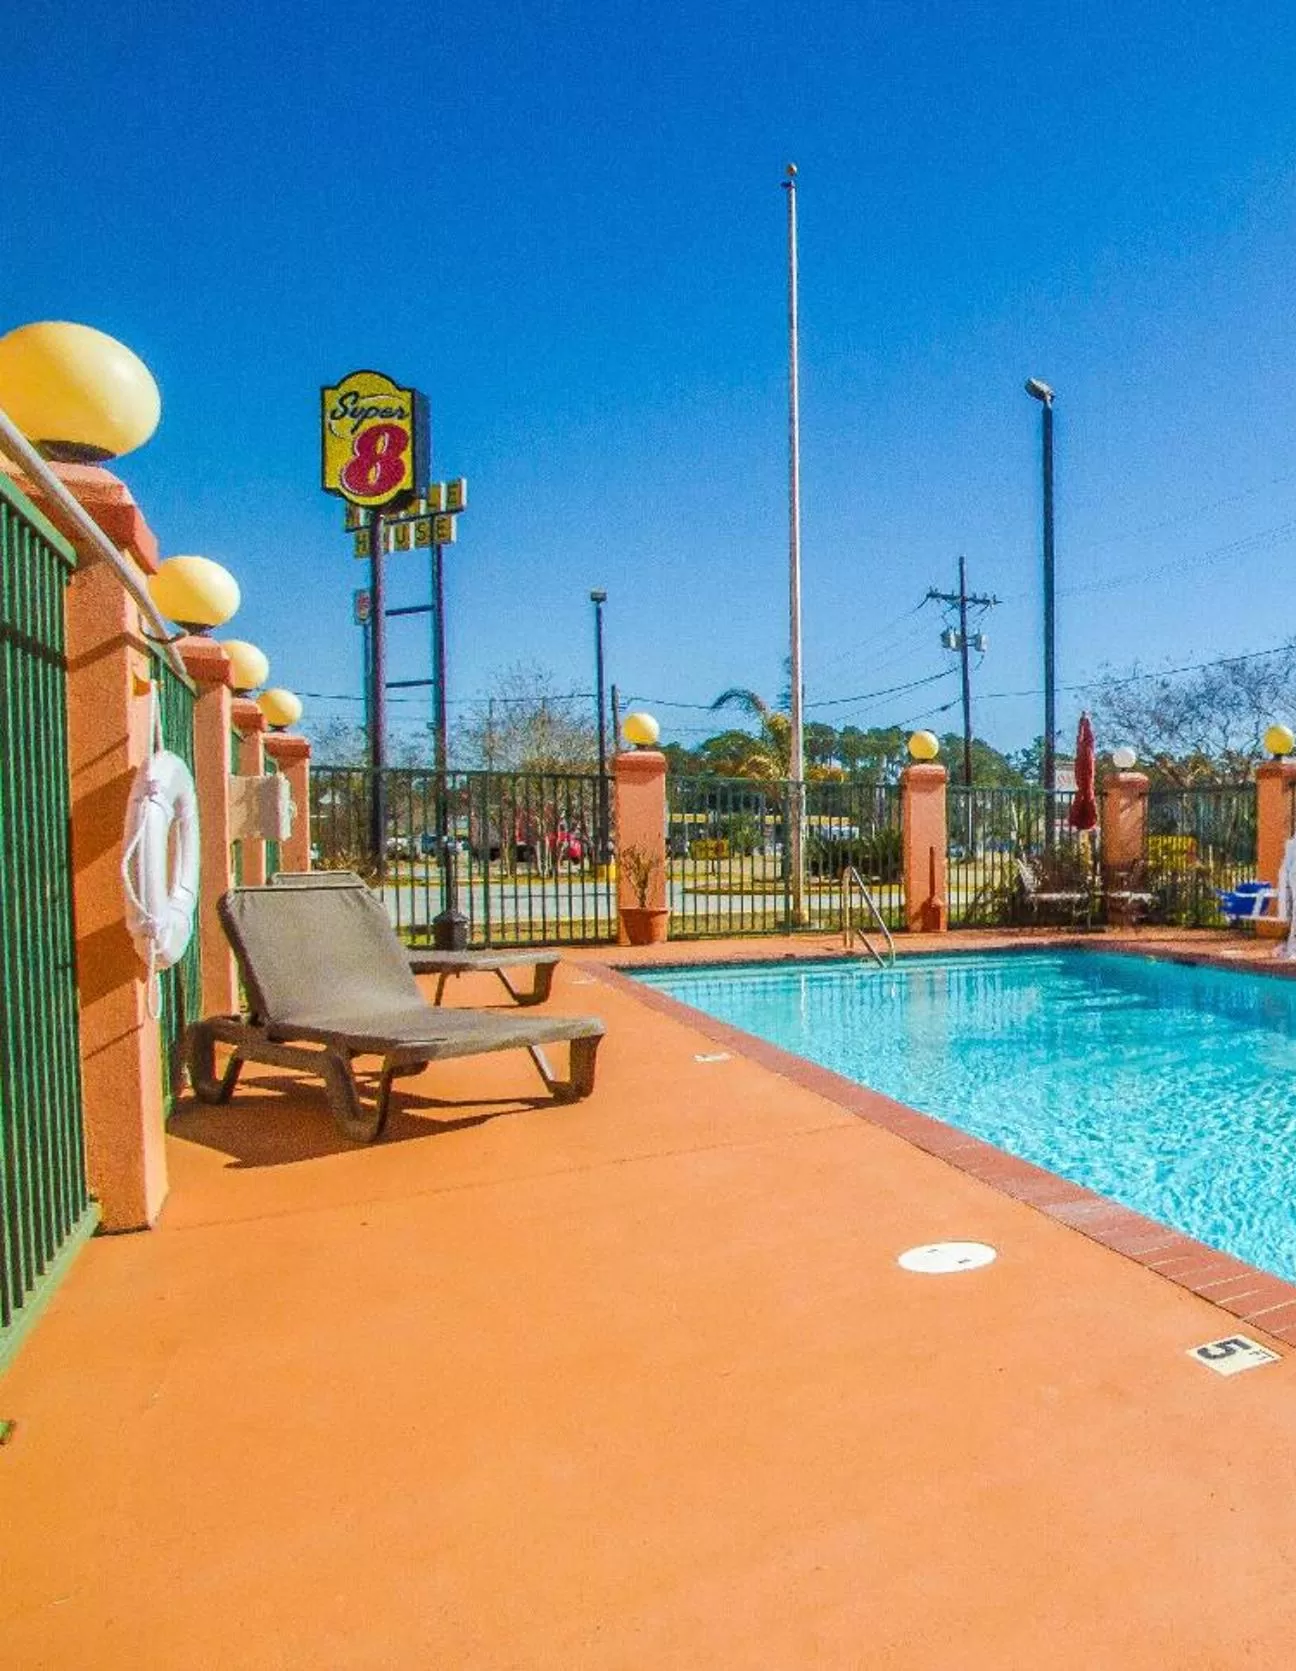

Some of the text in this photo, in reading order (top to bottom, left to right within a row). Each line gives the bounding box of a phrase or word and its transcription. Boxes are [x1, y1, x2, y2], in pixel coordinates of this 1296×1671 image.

[330, 391, 409, 434] Super
[341, 422, 410, 497] 8
[356, 517, 453, 557] HUSE
[1196, 1338, 1252, 1360] 5
